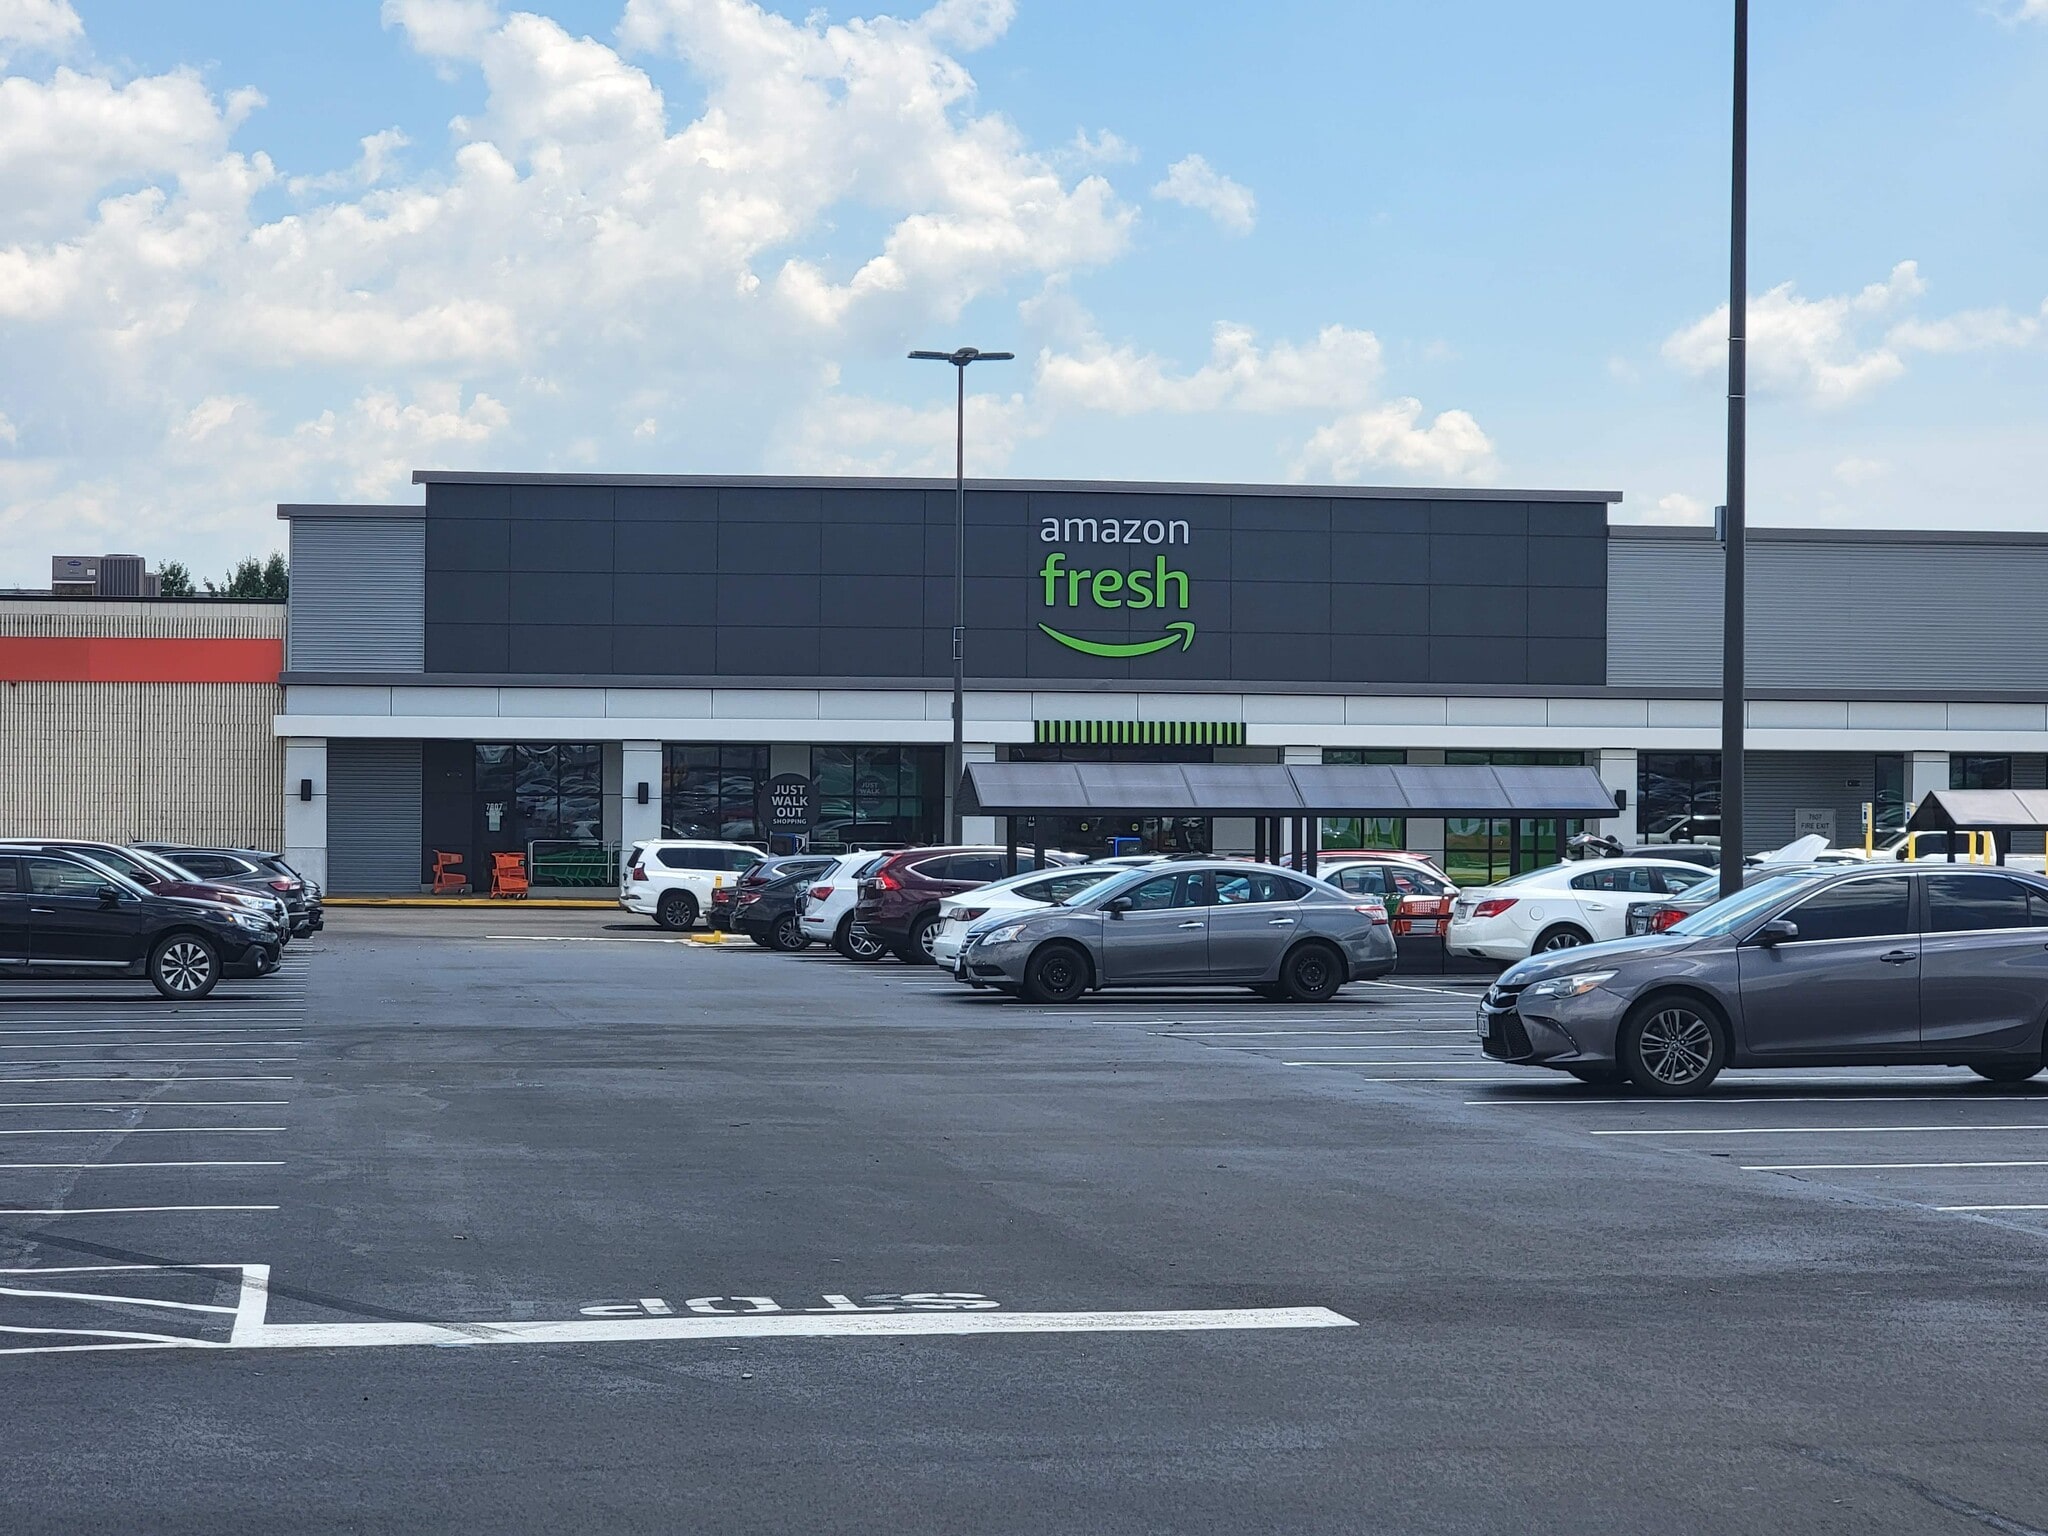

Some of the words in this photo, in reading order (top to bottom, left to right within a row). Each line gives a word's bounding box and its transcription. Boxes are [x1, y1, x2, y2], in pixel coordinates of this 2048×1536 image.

[1040, 516, 1190, 544] amazon
[1040, 553, 1189, 609] fresh
[774, 784, 806, 795] JUST
[771, 796, 809, 806] WALK
[776, 807, 804, 818] OUT
[578, 1292, 1001, 1317] STOP
